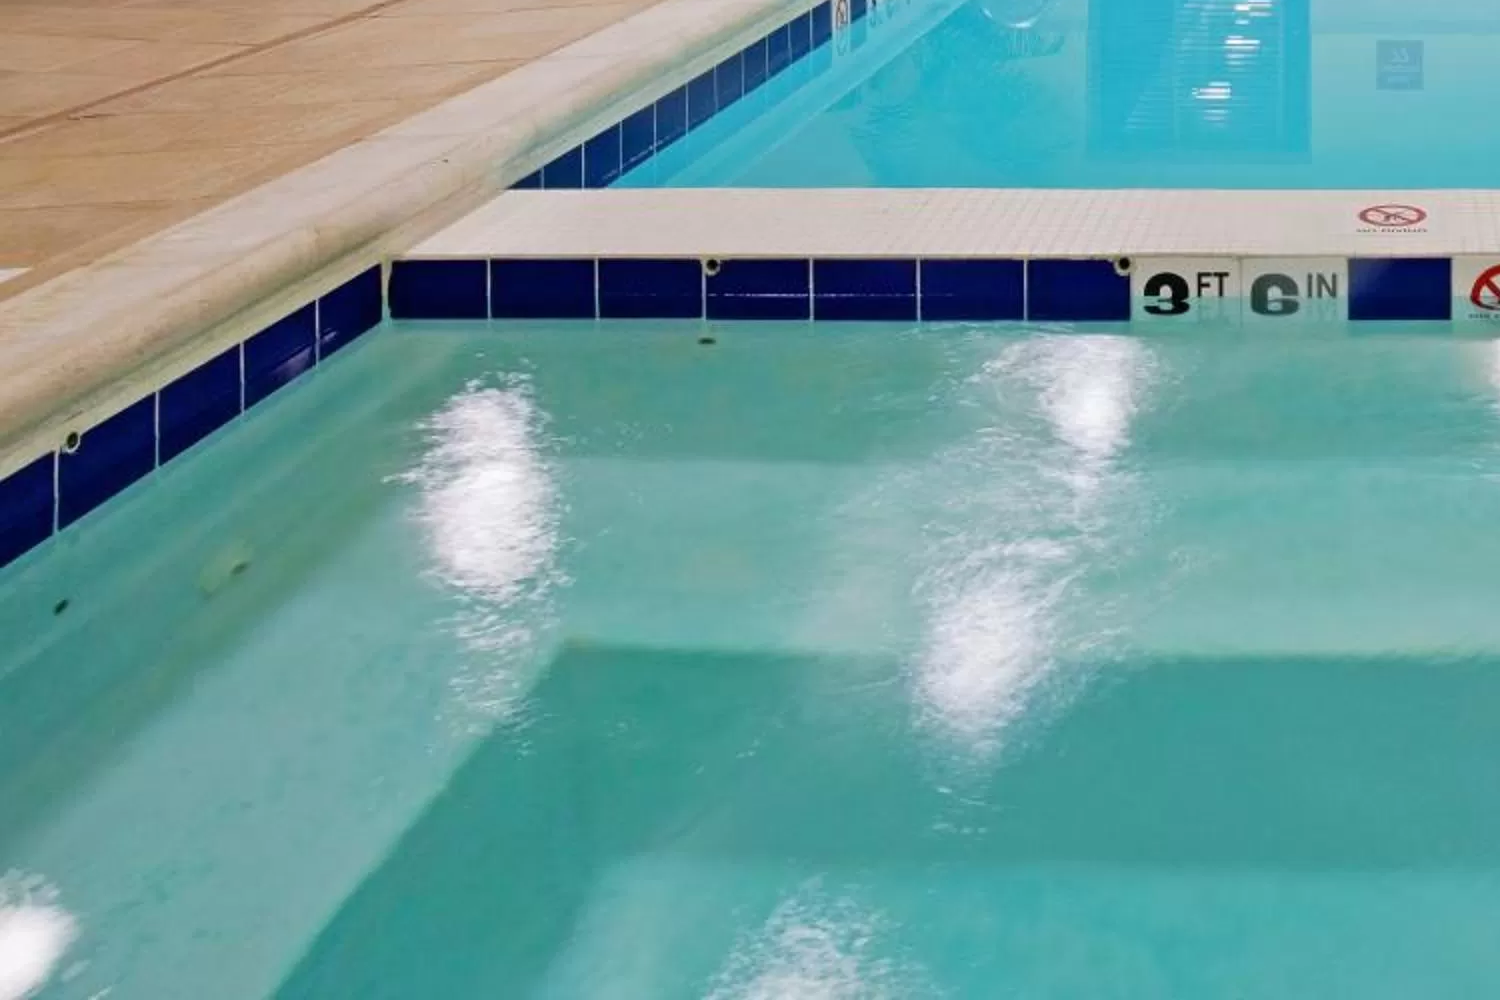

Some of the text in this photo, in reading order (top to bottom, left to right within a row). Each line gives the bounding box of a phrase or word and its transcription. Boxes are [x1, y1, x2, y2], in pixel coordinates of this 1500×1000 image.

[1143, 272, 1338, 316] 3 FT 6 IN
